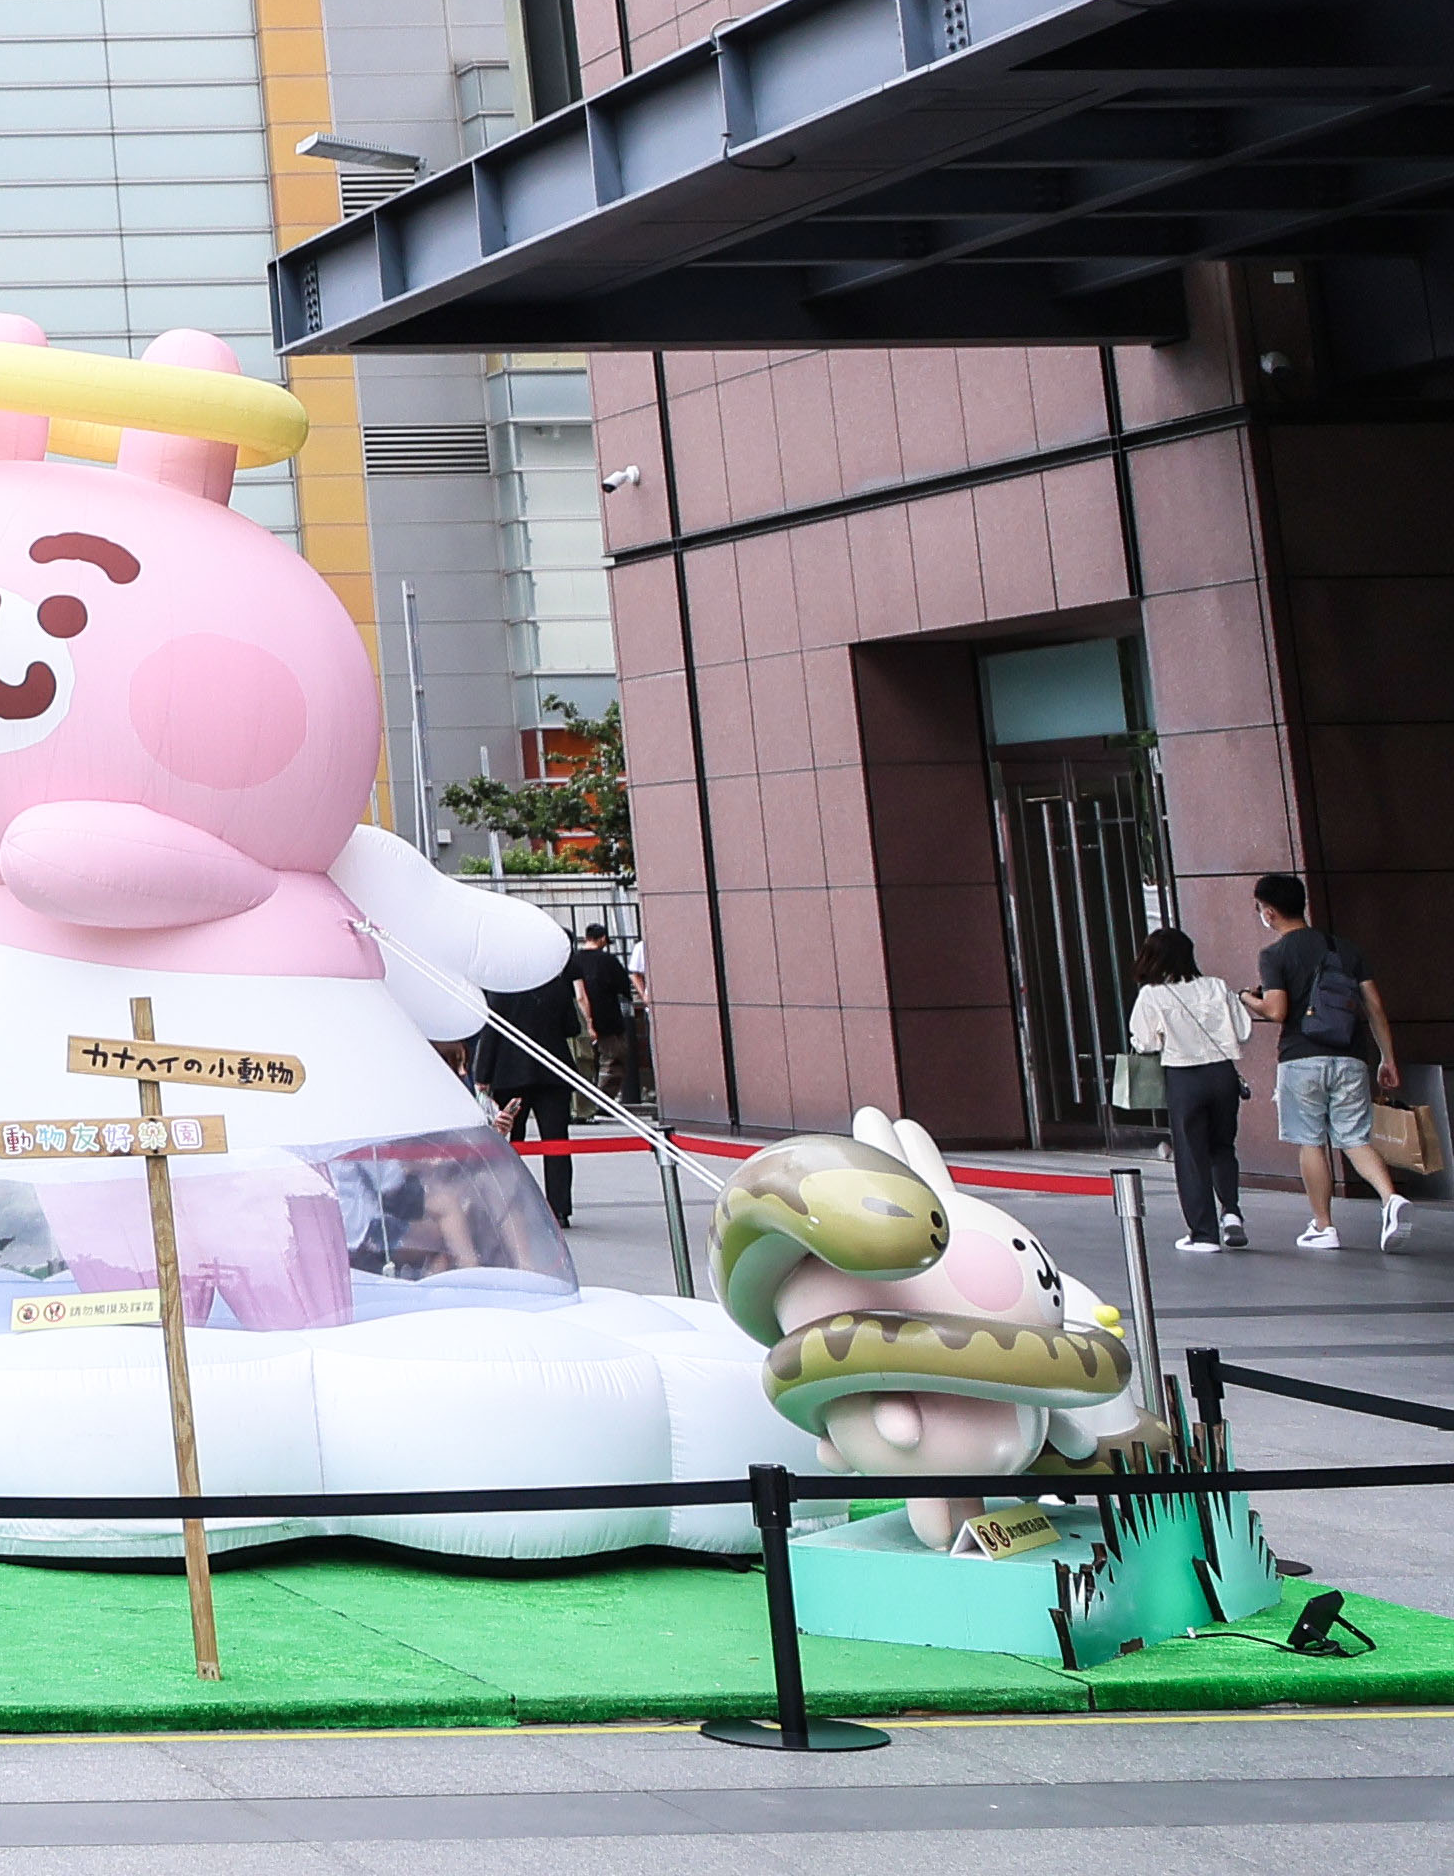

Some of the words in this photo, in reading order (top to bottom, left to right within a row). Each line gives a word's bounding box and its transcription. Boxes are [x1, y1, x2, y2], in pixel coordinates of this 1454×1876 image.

[82, 1042, 294, 1086] カナヘイの小動物
[3, 1119, 204, 1155] 動物友好樂園
